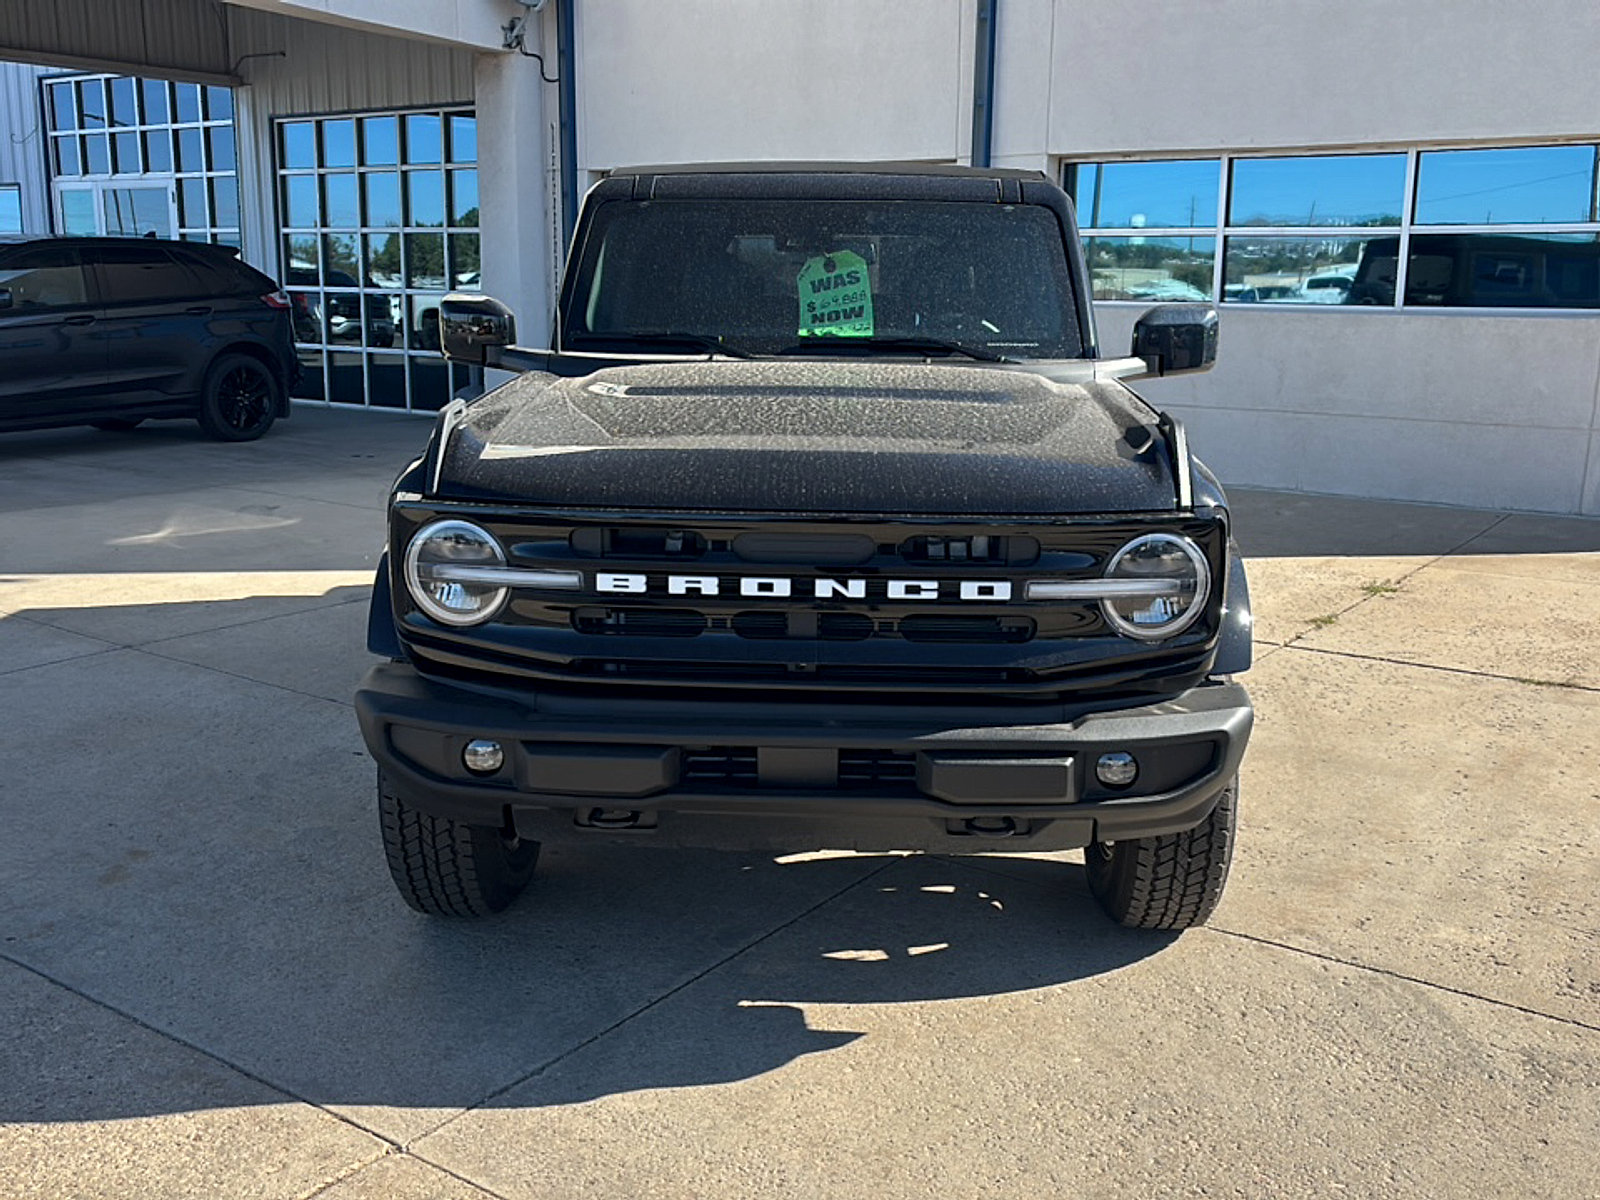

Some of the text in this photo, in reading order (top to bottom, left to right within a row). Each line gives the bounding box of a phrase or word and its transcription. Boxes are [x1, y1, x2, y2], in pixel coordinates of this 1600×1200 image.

[810, 270, 861, 293] WAS
[811, 305, 864, 324] NOW
[596, 573, 1012, 600] BRONCO
